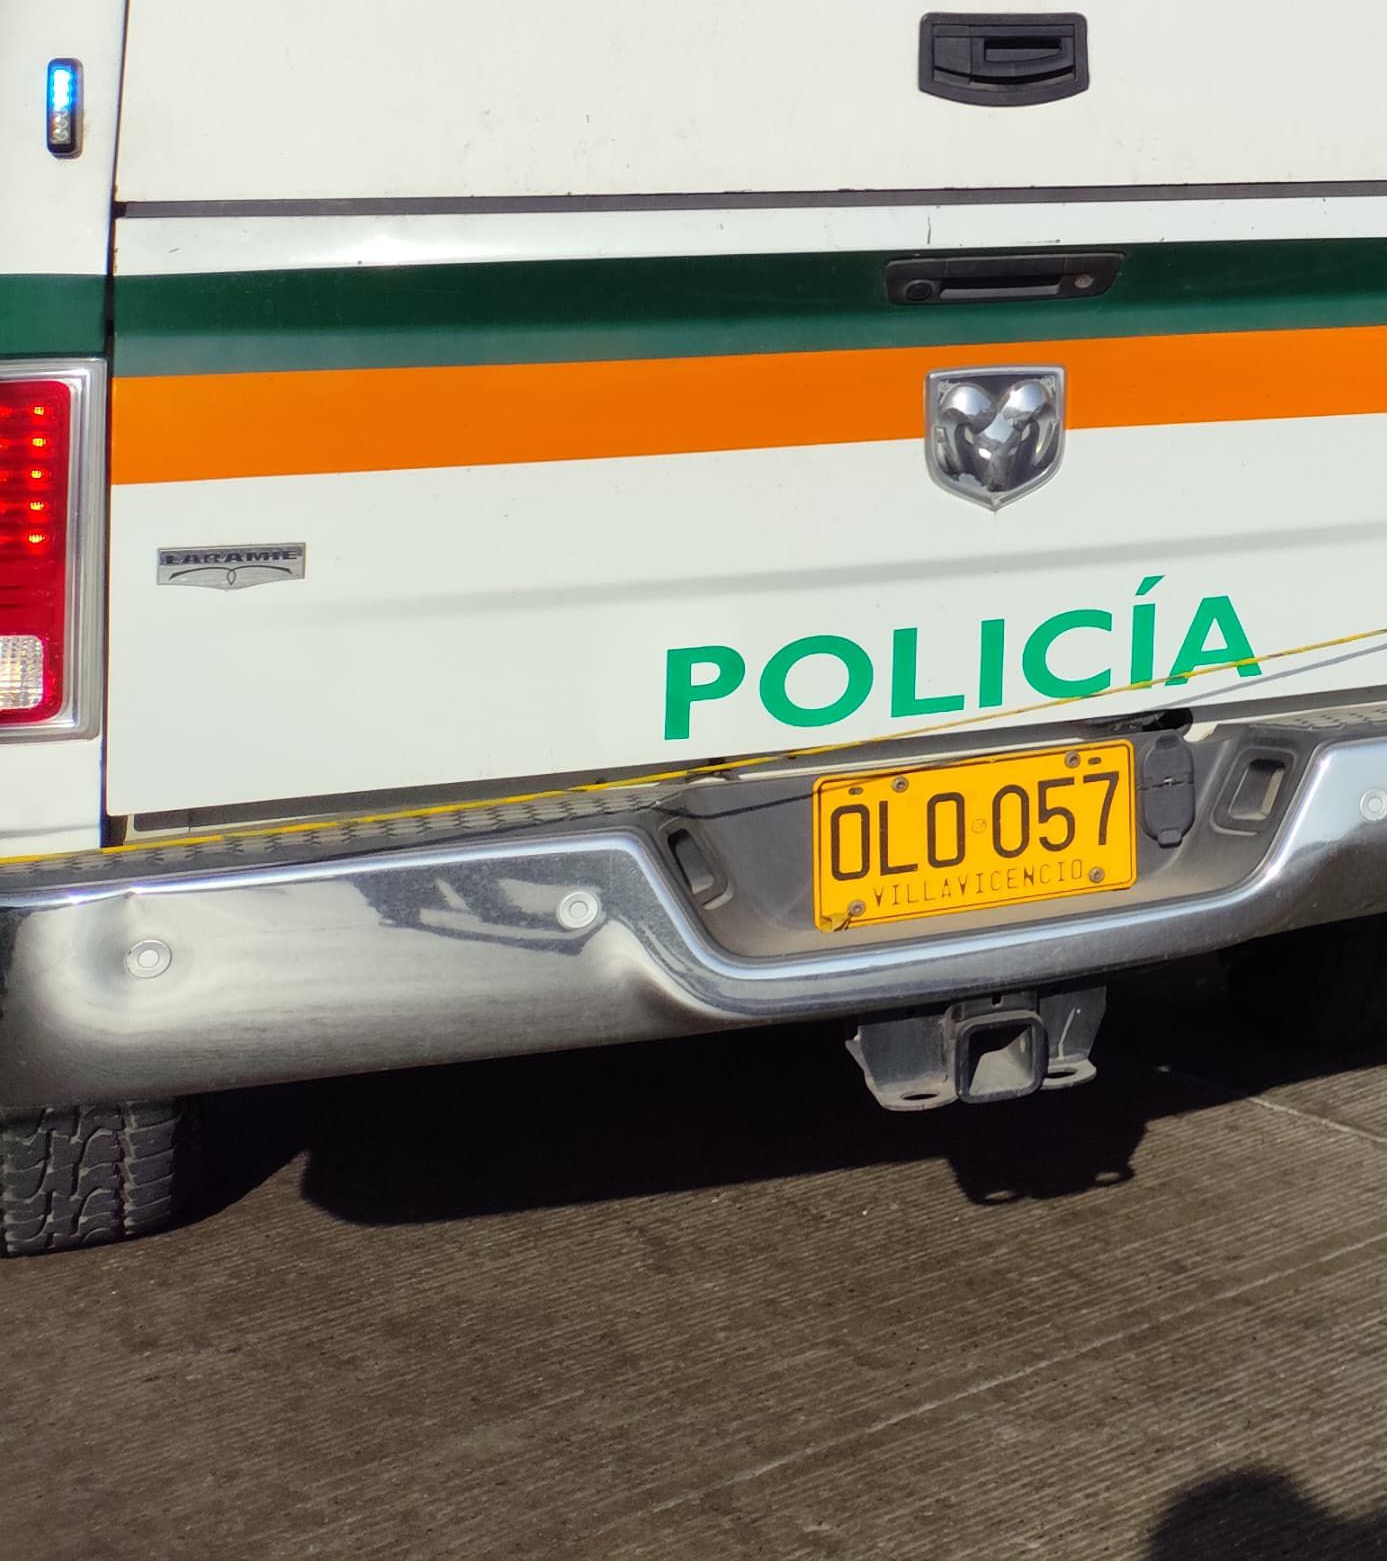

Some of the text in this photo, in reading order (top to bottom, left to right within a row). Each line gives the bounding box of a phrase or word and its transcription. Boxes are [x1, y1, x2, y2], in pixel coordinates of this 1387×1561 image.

[165, 550, 298, 565] LARAMIE
[664, 575, 1263, 742] POLICÍA
[830, 771, 1120, 882] OLO 057
[872, 858, 1083, 909] VILLAVICENCIO
